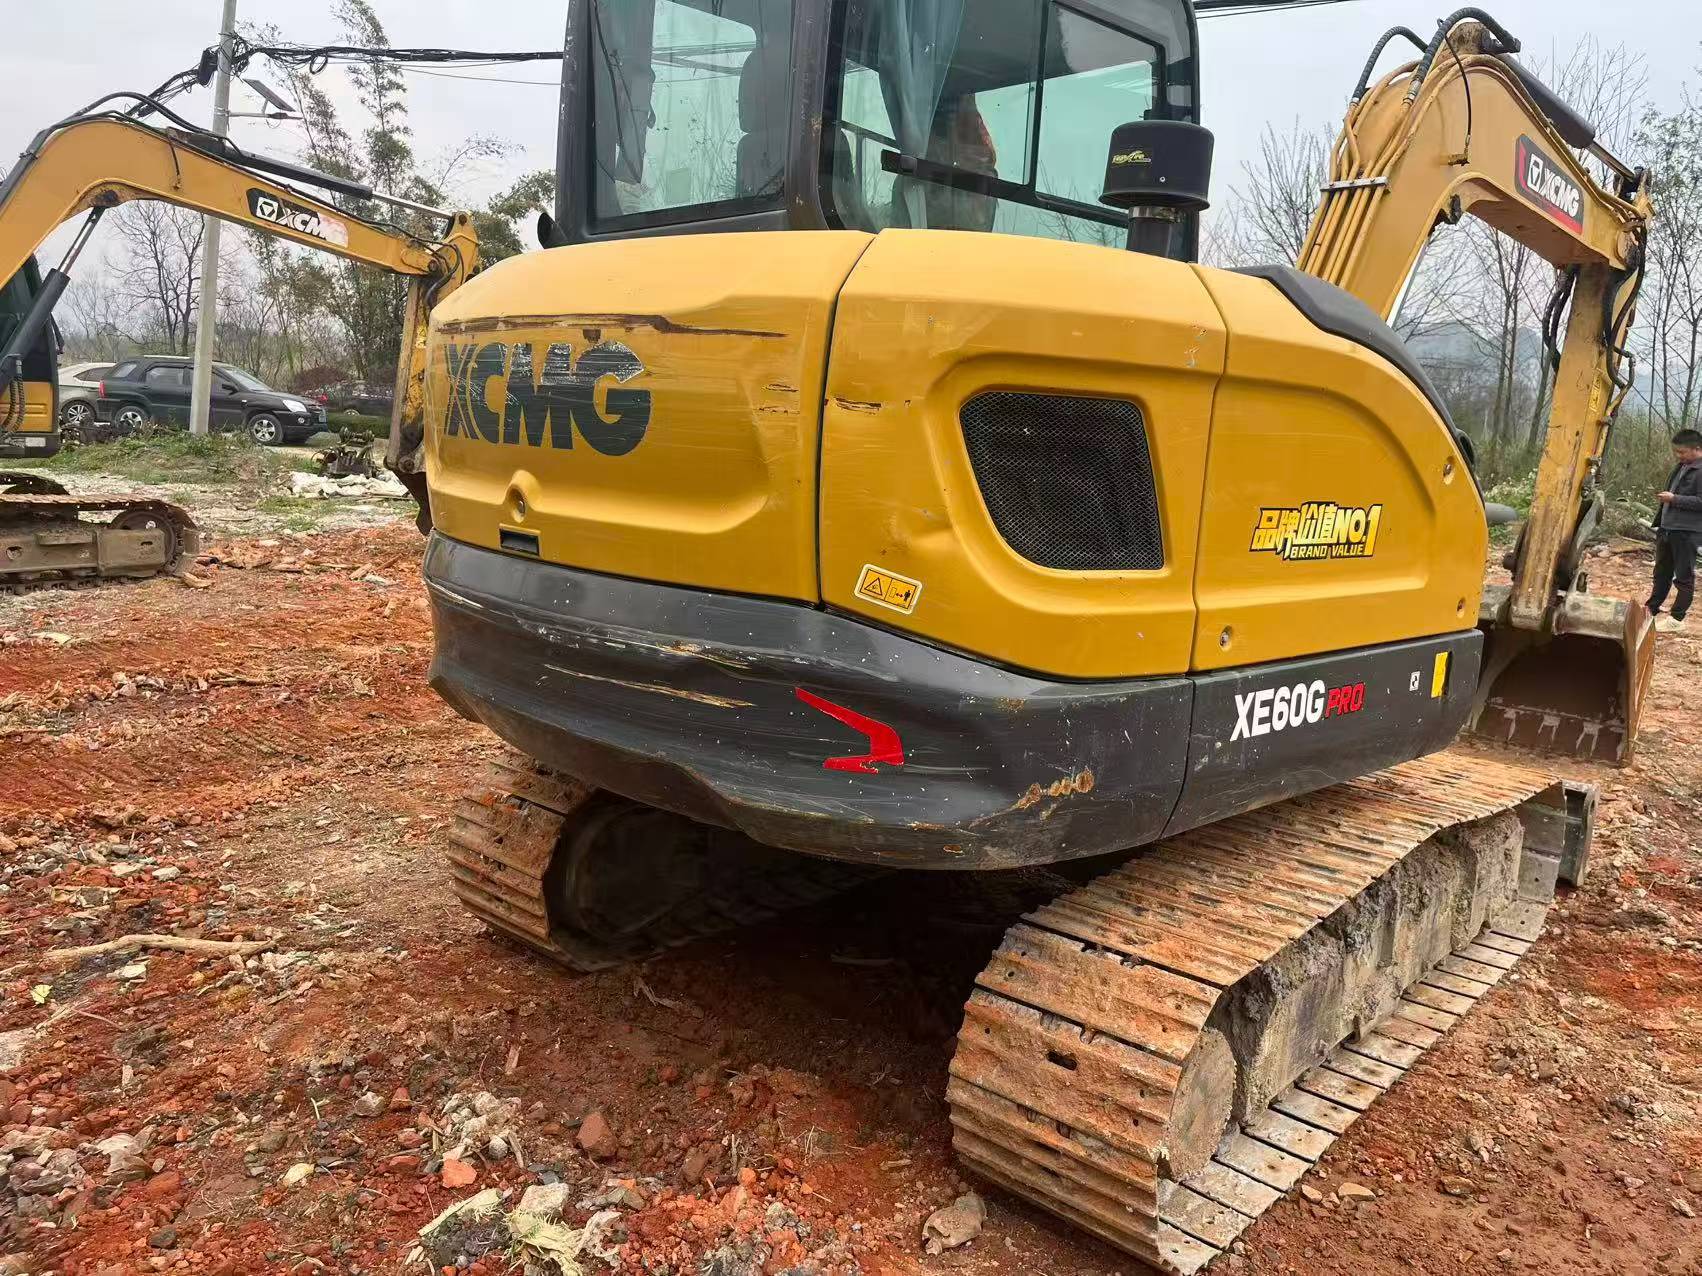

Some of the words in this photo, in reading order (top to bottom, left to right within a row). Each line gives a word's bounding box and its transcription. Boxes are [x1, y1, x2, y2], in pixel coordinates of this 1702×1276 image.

[1540, 167, 1579, 217] XCMG
[444, 341, 652, 457] XCMG
[1290, 545, 1328, 559] BRAND
[1331, 544, 1364, 556] VALUE
[1230, 679, 1326, 742] XE60G
[1325, 681, 1366, 718] PRO
